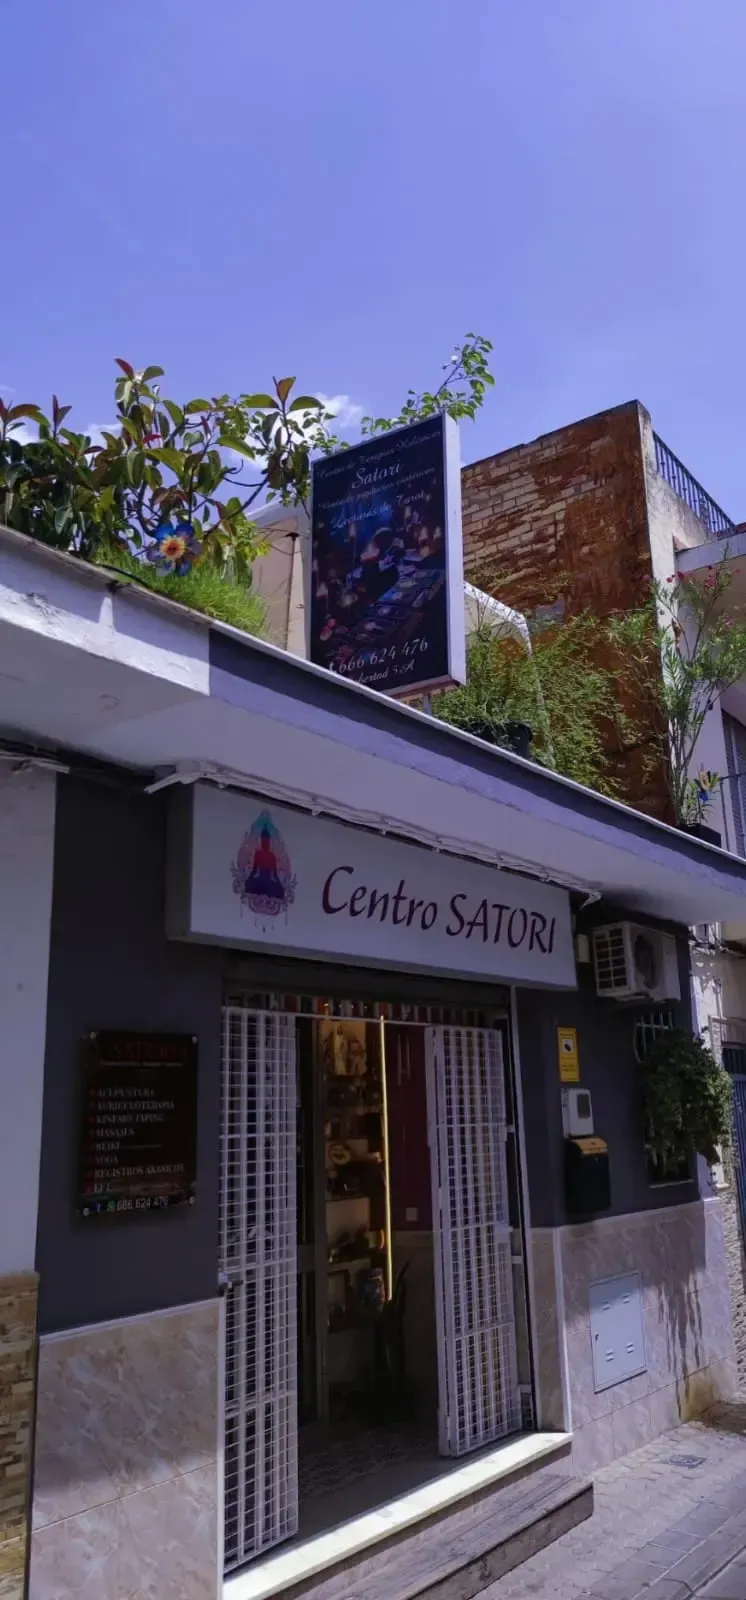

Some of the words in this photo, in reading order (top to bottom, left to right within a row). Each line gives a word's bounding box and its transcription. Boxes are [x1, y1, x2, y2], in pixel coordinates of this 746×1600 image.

[351, 459, 404, 489] Satori
[395, 489, 425, 507] Tarot
[369, 645, 396, 665] 624
[401, 636, 428, 656] 476
[321, 865, 438, 931] Centro
[445, 893, 556, 955] SATORI
[94, 1155, 119, 1165] YOGA
[93, 1166, 145, 1179] REGISTROS
